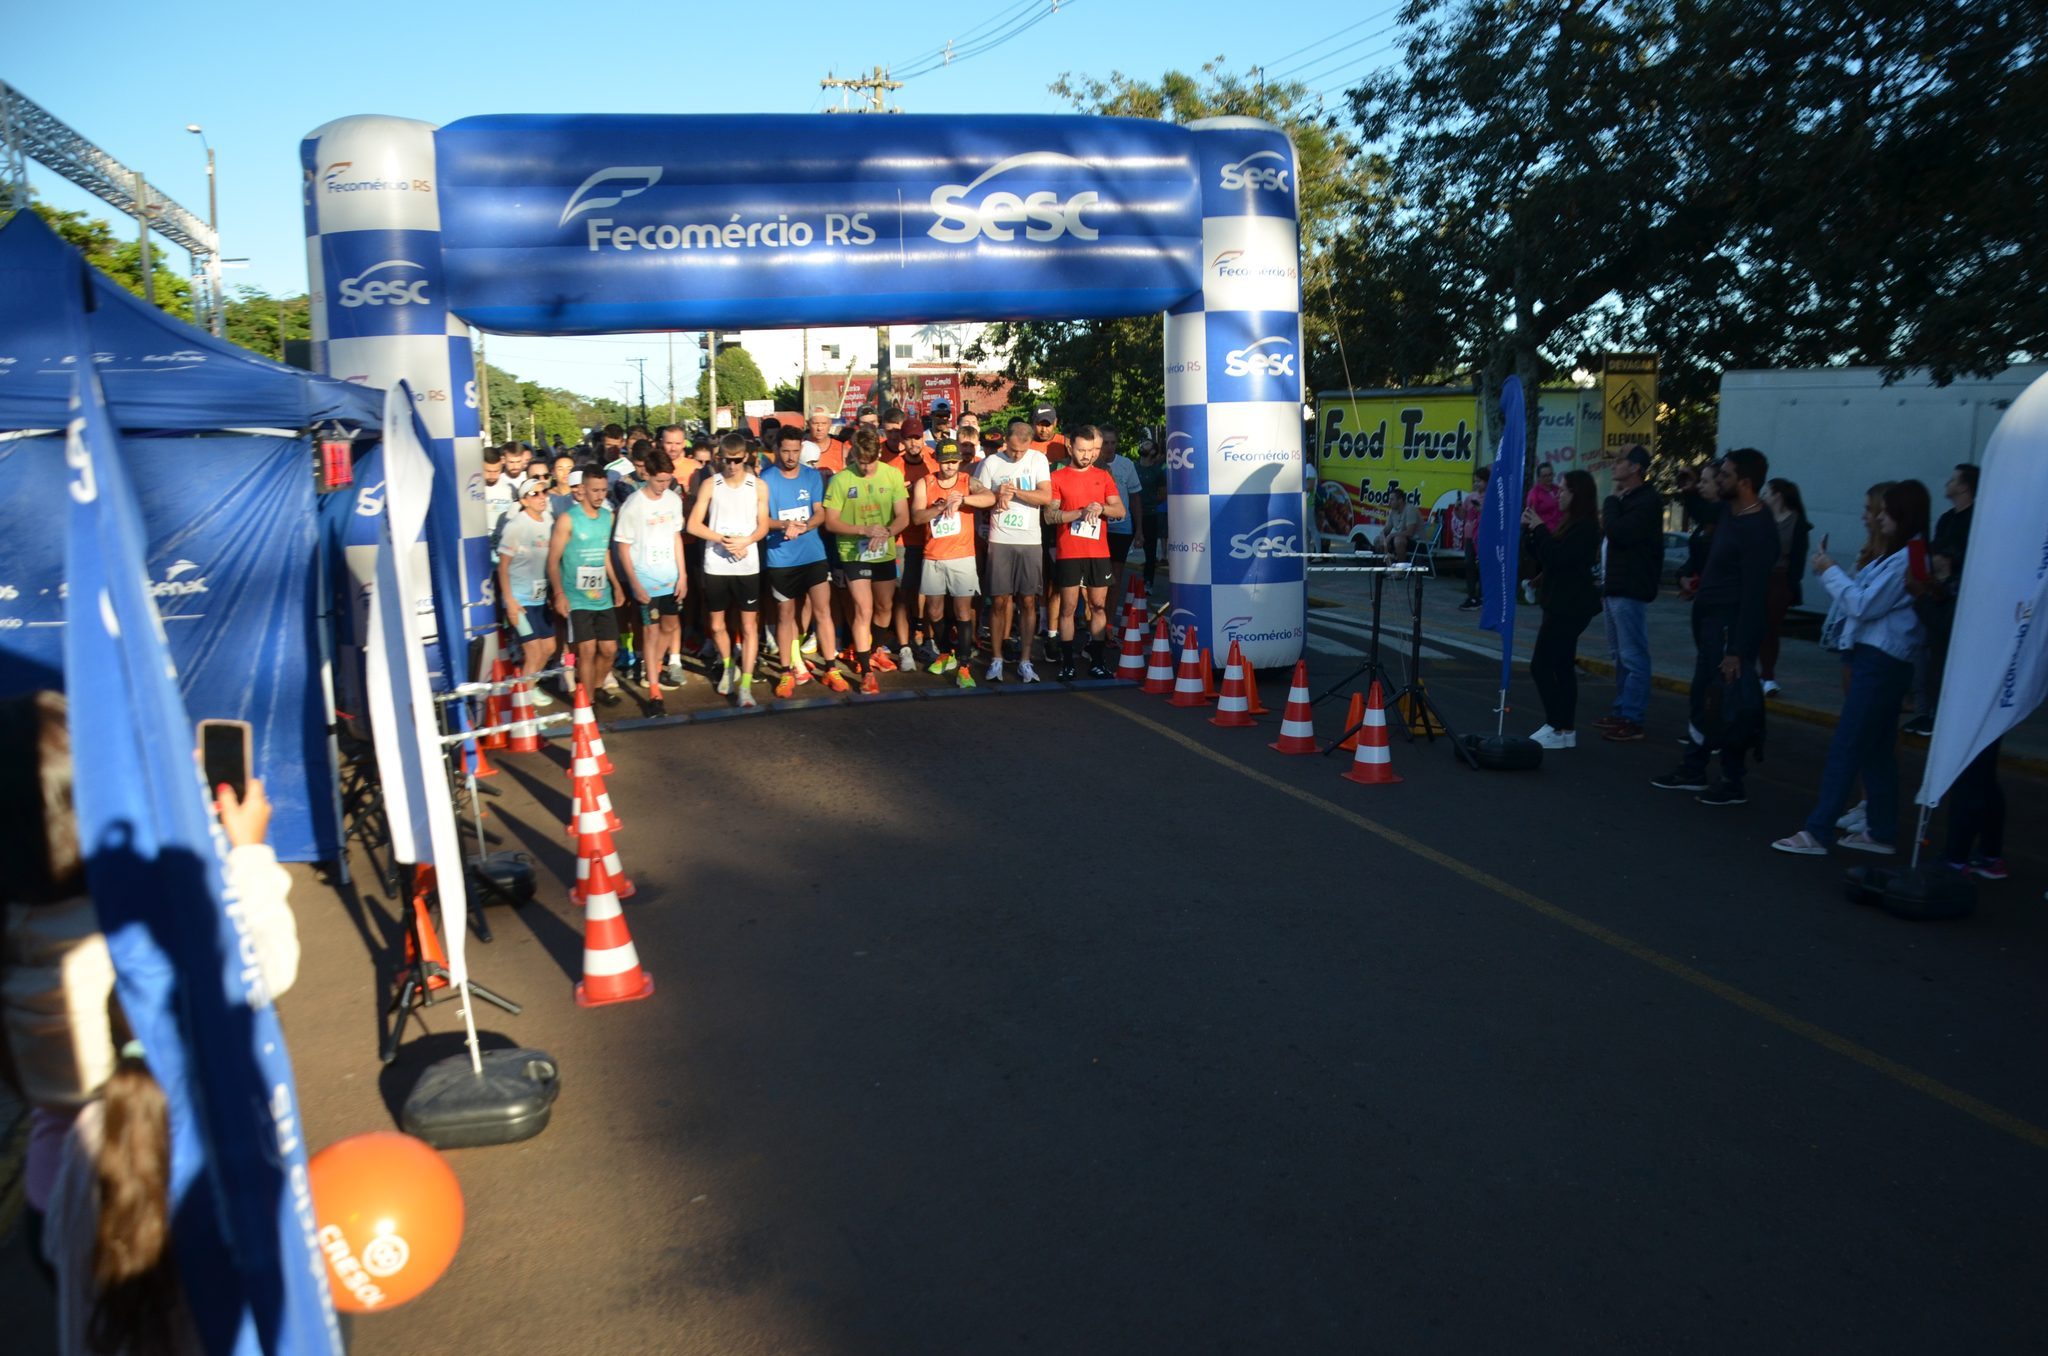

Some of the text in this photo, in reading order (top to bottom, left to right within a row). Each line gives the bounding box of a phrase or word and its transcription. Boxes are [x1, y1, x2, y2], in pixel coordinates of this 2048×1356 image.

[327, 178, 432, 193] Fecomércio RS
[1219, 163, 1289, 193] Sesc
[928, 184, 1101, 243] Sesc
[587, 213, 876, 251] Fecomércio RS
[338, 277, 431, 308] Sesc
[1187, 361, 1201, 372] RS
[1224, 349, 1294, 378] Sesc
[428, 390, 447, 402] RS
[1322, 408, 1473, 462] Food Truck
[1167, 447, 1195, 470] esc
[1224, 447, 1301, 462] Fecomércio RS
[1003, 513, 1024, 528] 423
[1191, 542, 1206, 553] RS
[1228, 533, 1297, 559] Sesc
[581, 575, 605, 589] 781
[1228, 627, 1303, 643] Fecomércio RS
